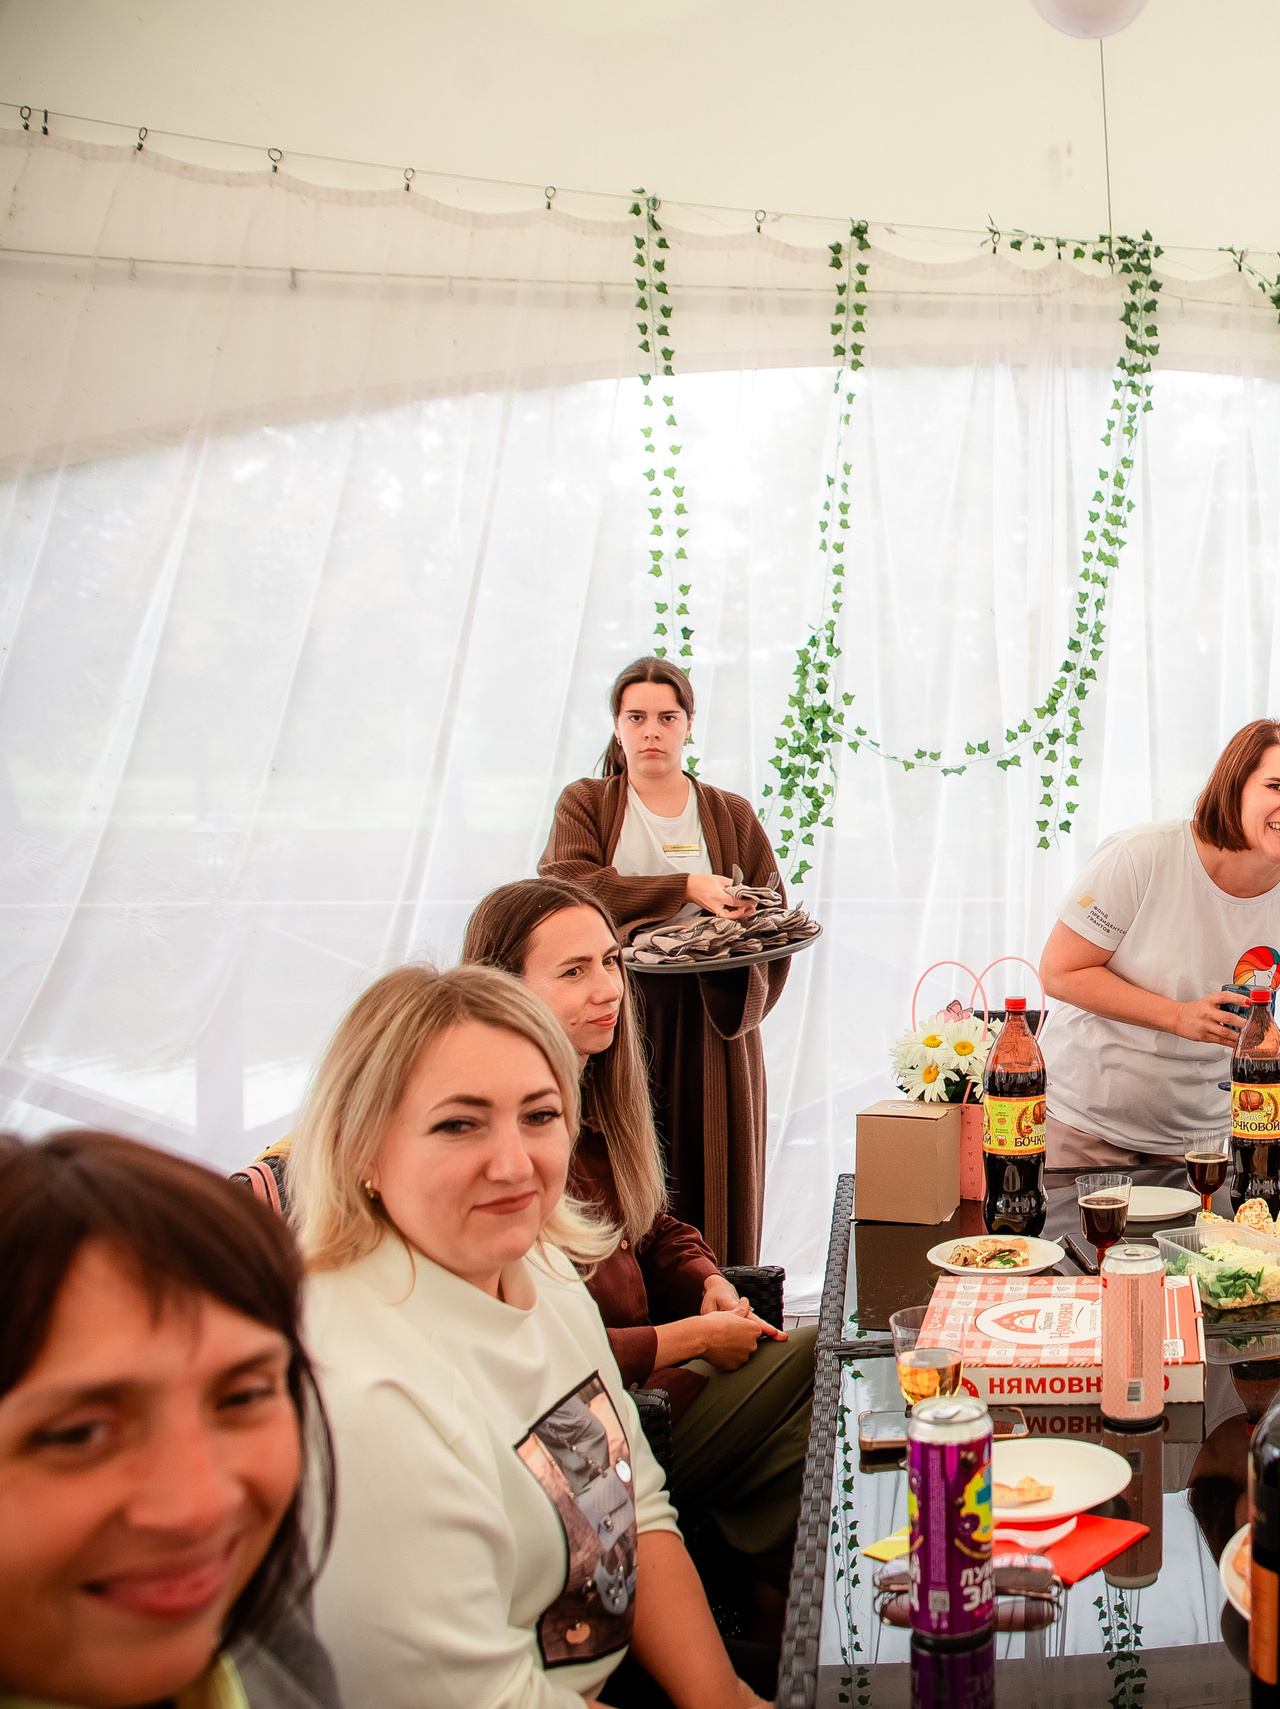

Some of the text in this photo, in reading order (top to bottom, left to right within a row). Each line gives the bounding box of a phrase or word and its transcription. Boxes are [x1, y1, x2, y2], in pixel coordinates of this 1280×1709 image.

[1093, 905, 1109, 919] ФОНД
[1086, 915, 1111, 934] ГРАНТОВ
[1240, 1112, 1263, 1121] КВАС
[1231, 1119, 1280, 1133] ОЧКОВОЙ
[1014, 1133, 1046, 1148] БОЧКО
[989, 1375, 1104, 1394] НЯМОВН
